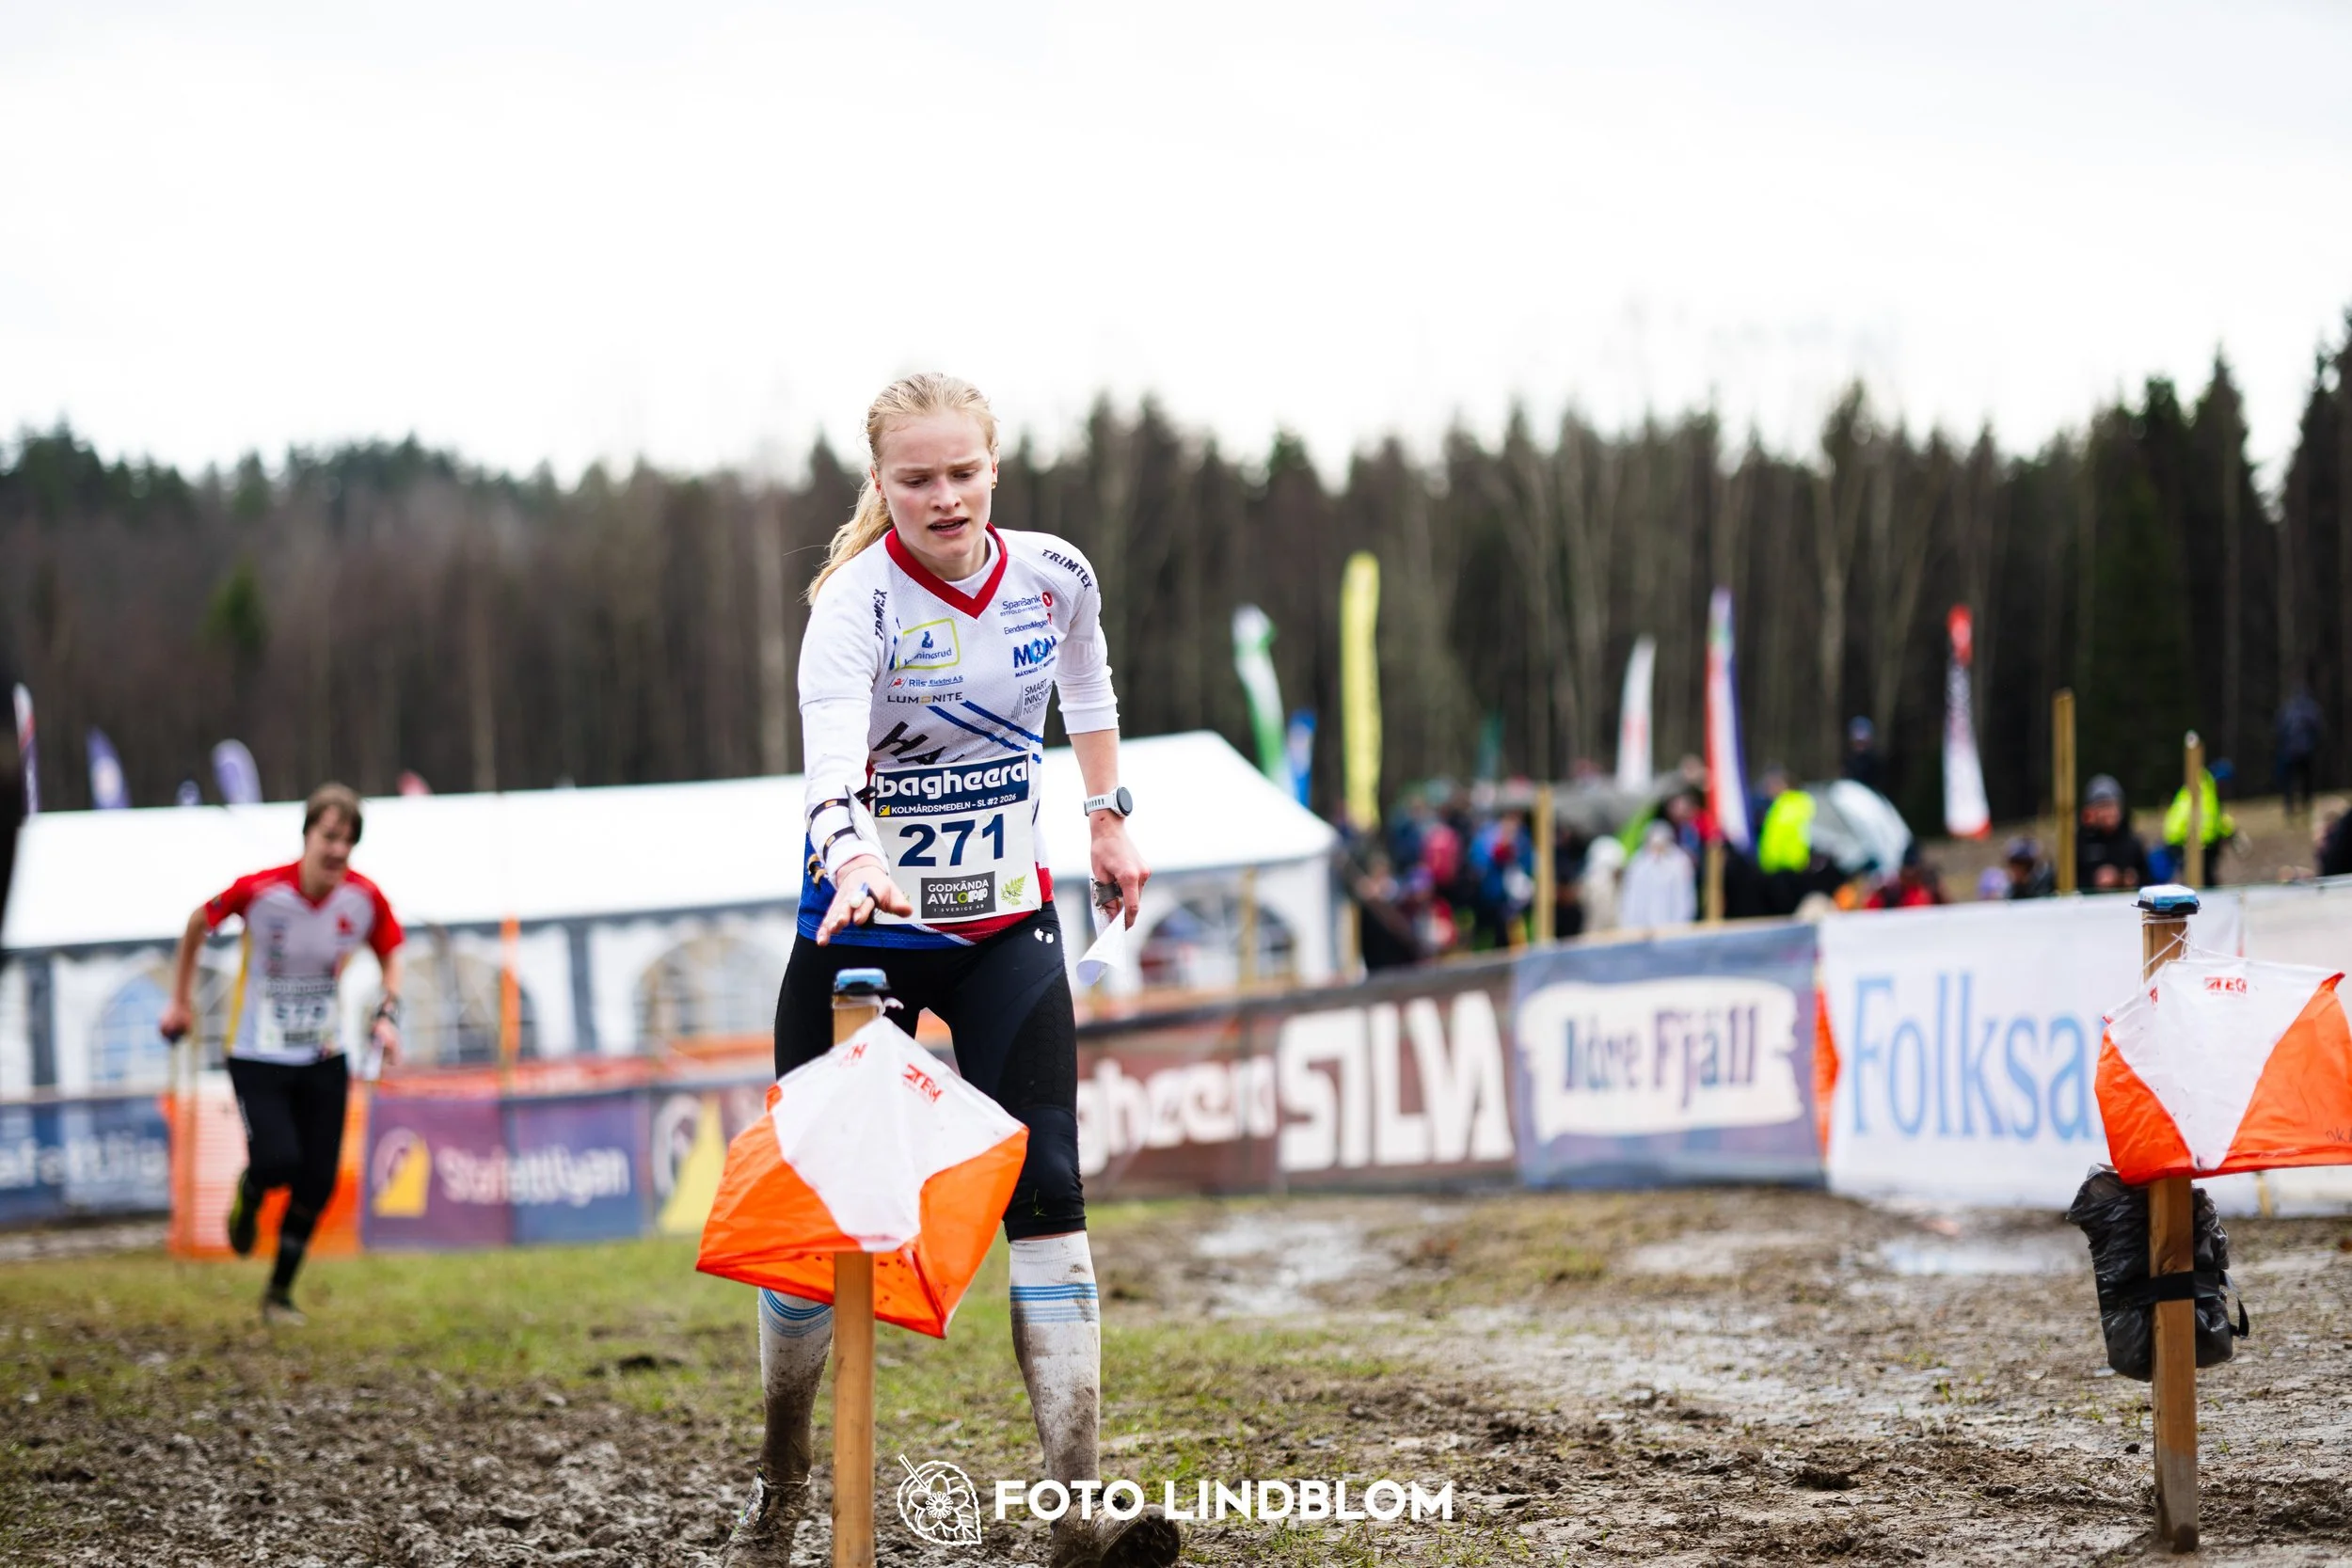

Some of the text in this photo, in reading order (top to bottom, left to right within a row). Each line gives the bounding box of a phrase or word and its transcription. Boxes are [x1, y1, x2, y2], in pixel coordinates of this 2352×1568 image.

[1041, 549, 1092, 592] TRIMTEX
[887, 692, 962, 704] LUMONITE
[1025, 678, 1047, 696] SMART
[877, 762, 1028, 800] bagheera
[891, 800, 971, 815] KOLMÅRDSMEDELN
[987, 797, 998, 805] #2
[999, 793, 1019, 803] 2026
[898, 814, 1004, 867] 271
[928, 879, 989, 893] GODKÄNDA
[941, 905, 973, 913] SVERIGE
[1653, 1004, 1756, 1108] Fjäll
[1852, 971, 2106, 1142] Folksa
[1278, 990, 1514, 1173] SILVA
